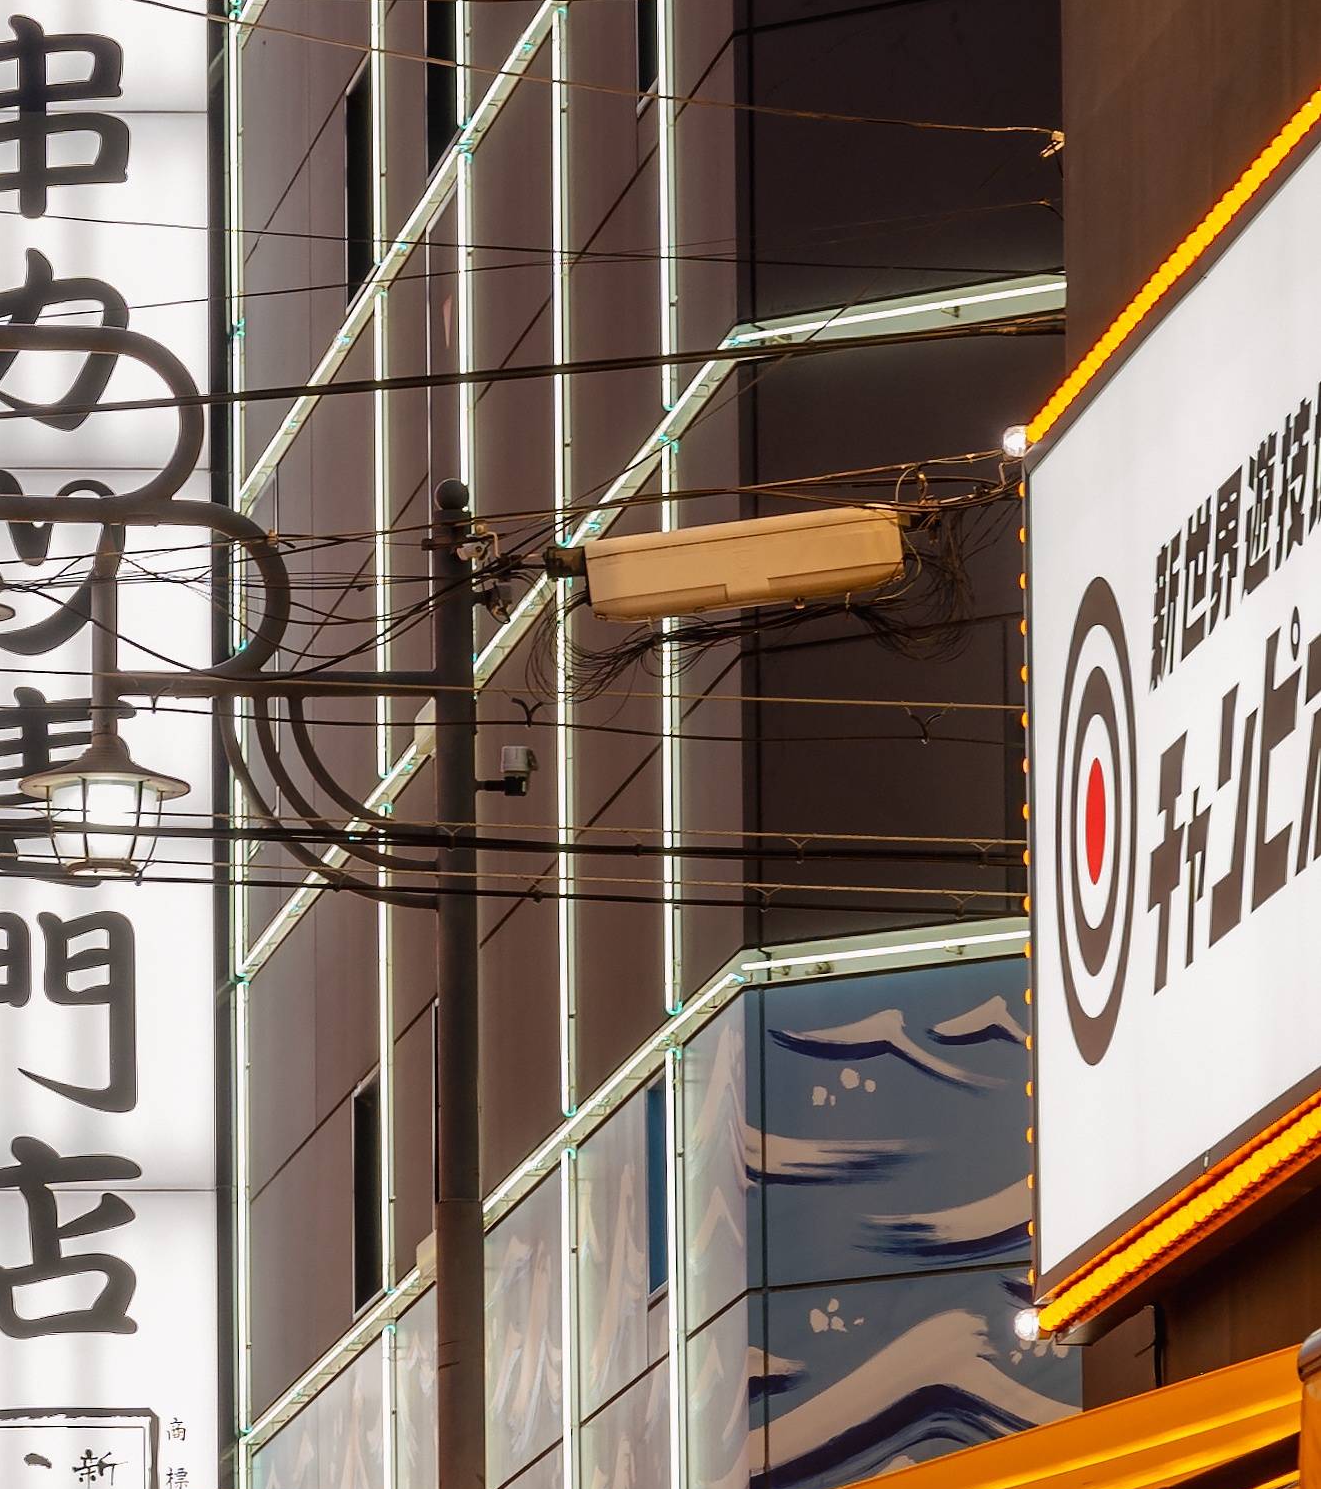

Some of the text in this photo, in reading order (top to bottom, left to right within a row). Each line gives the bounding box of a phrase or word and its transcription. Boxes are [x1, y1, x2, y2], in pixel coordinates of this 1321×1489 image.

[1150, 381, 1321, 693] 新世界遊技
